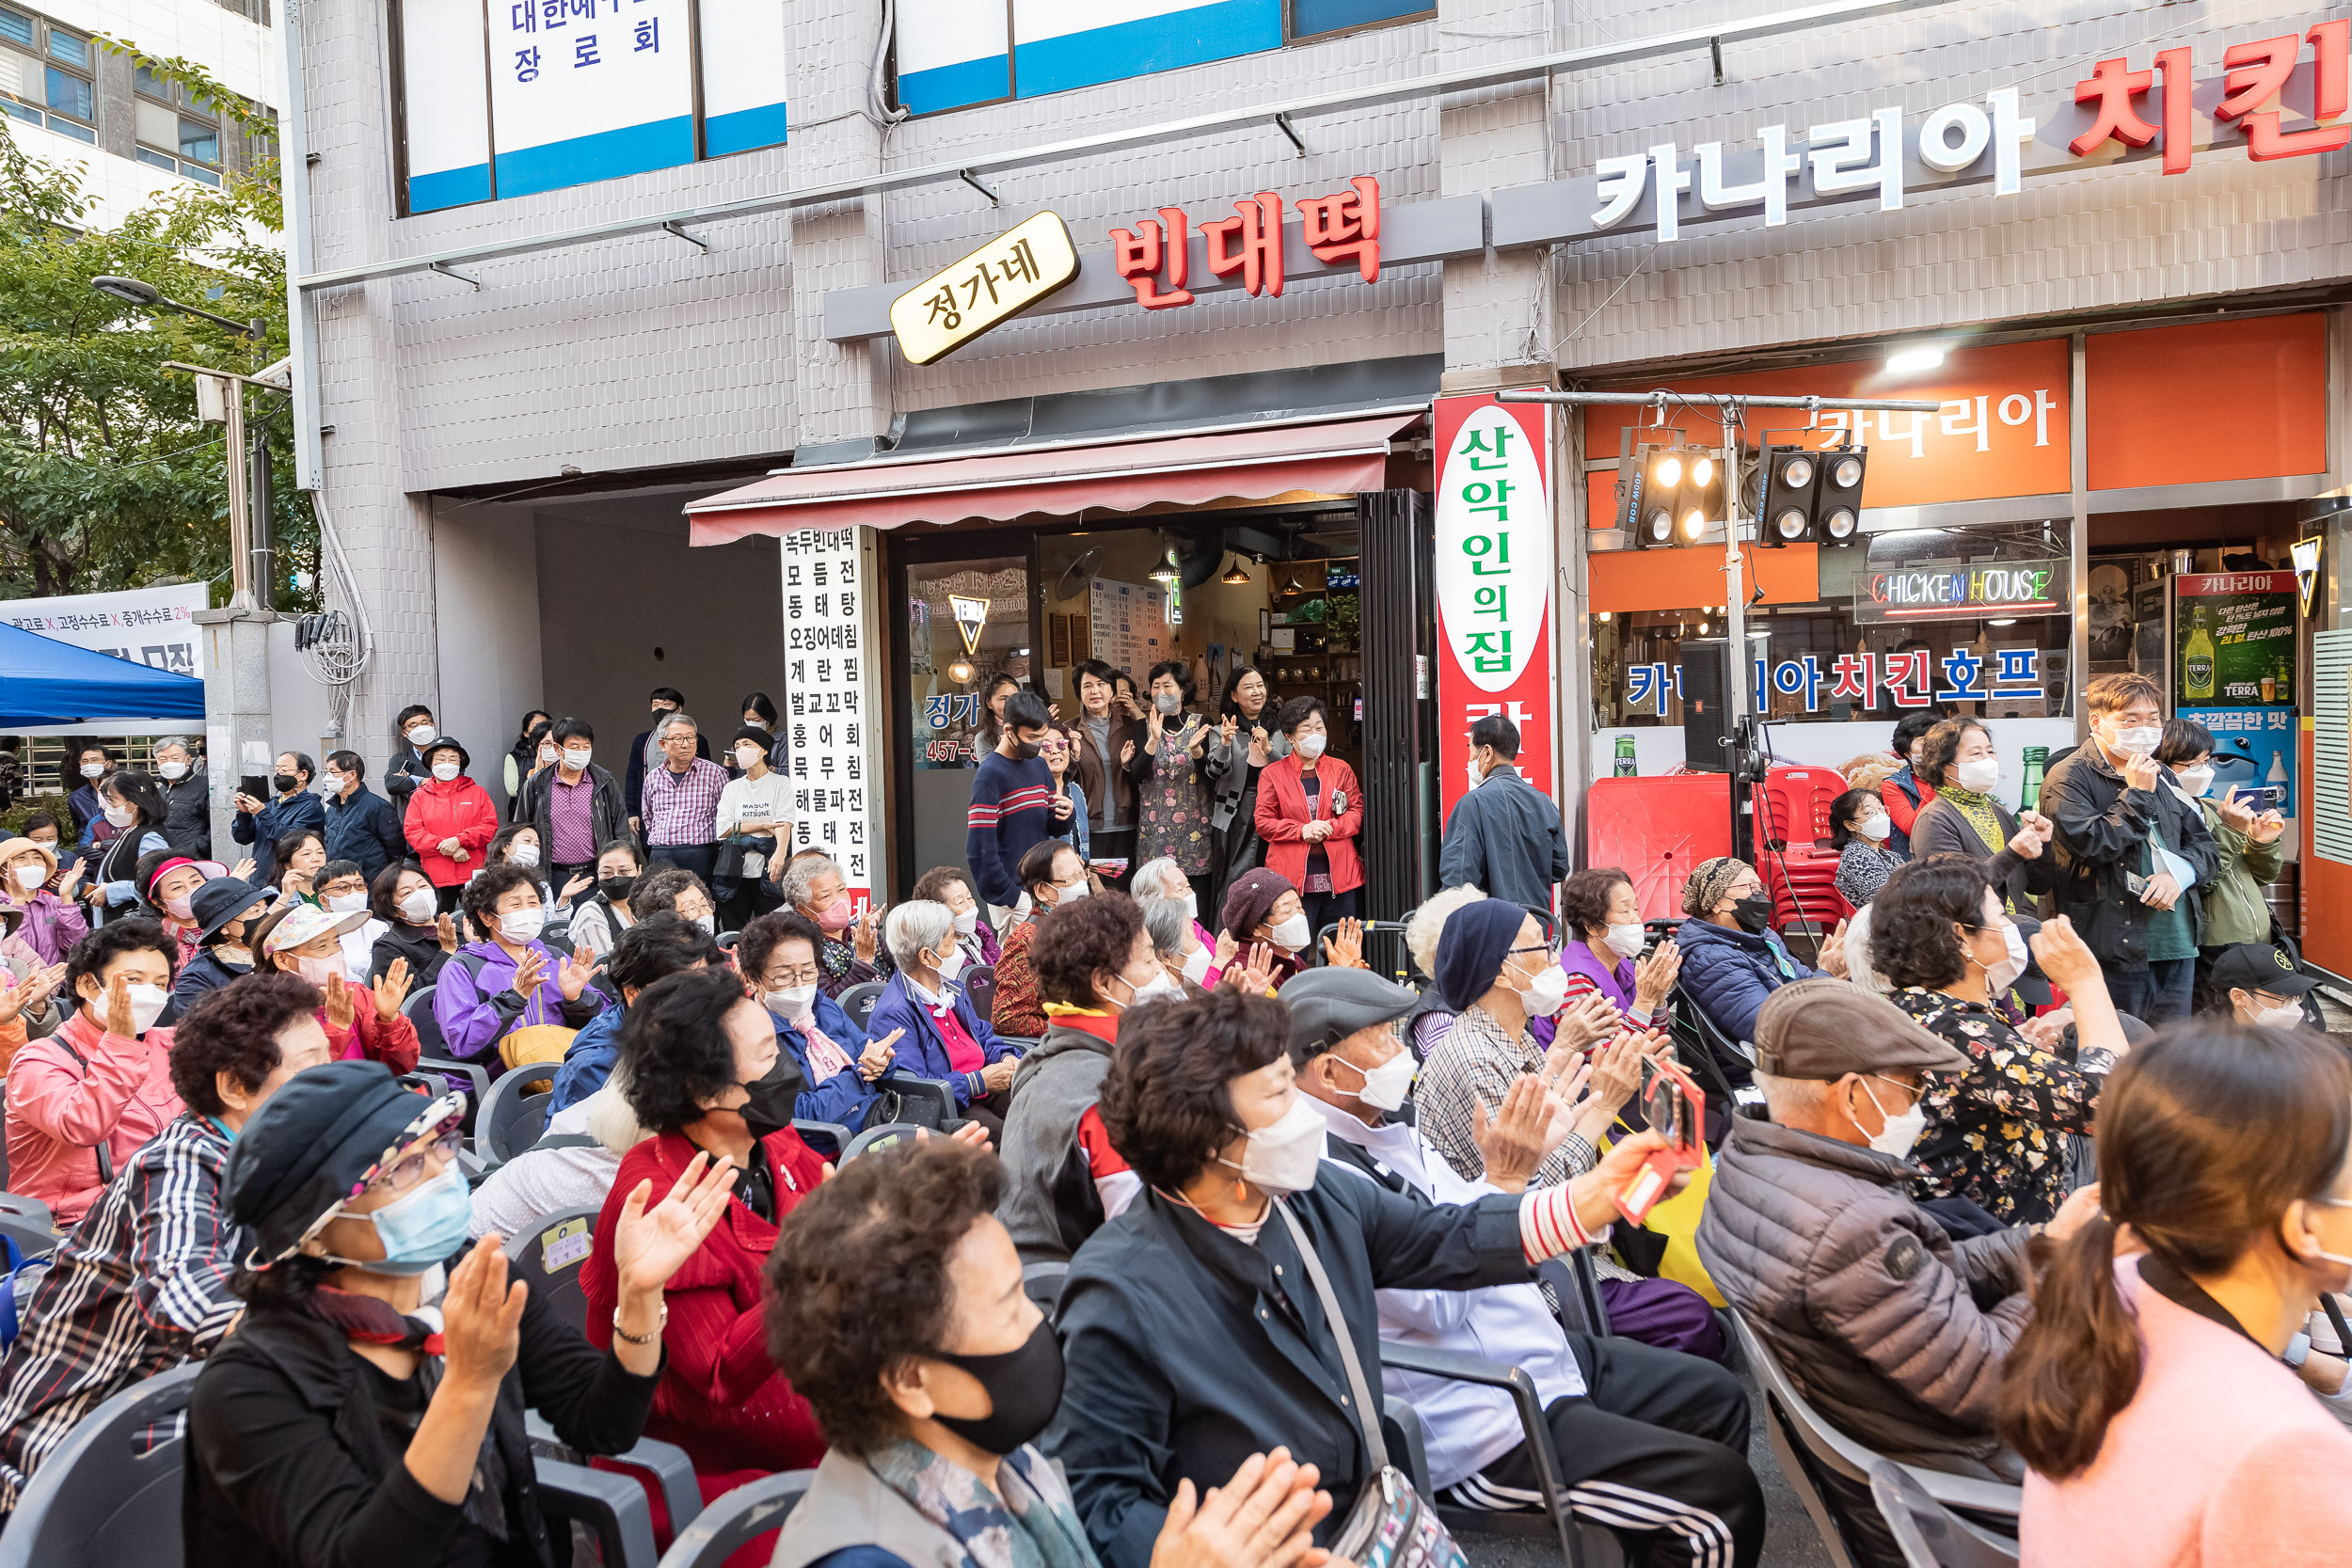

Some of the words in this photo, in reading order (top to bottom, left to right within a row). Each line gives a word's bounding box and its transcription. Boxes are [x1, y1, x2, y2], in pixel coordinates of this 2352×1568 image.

[1591, 87, 2036, 242] 카나리아
[2069, 19, 2352, 175] 치킨
[1109, 176, 1380, 311] 빈대떡
[923, 237, 1041, 328] 정가네
[1818, 388, 2057, 458] 카나리아
[1632, 472, 1642, 500] 400W
[1629, 501, 1637, 523] COB
[786, 527, 853, 556] 녹두빈대떡
[787, 559, 855, 587] 모듬전
[1871, 573, 1965, 604] CHICKEN
[1970, 569, 2048, 601] HOUSE
[2201, 576, 2273, 593] 카나리아
[57, 613, 111, 630] 고정수수료
[122, 608, 173, 627] 중개수수료
[173, 605, 191, 620] 2%
[788, 592, 856, 620] 동태탕
[789, 624, 857, 651] 오징어데침
[2268, 625, 2293, 638] 100%
[790, 657, 858, 684] 계란찜
[791, 689, 858, 716] 벌교꼬막
[2223, 686, 2259, 697] TERRA
[924, 691, 981, 729] 정가
[2267, 711, 2288, 731] 맛
[792, 722, 861, 749] 홍어회
[1615, 757, 1635, 766] TERRA
[795, 786, 863, 813] 해물파전
[797, 819, 864, 845] 동태전
